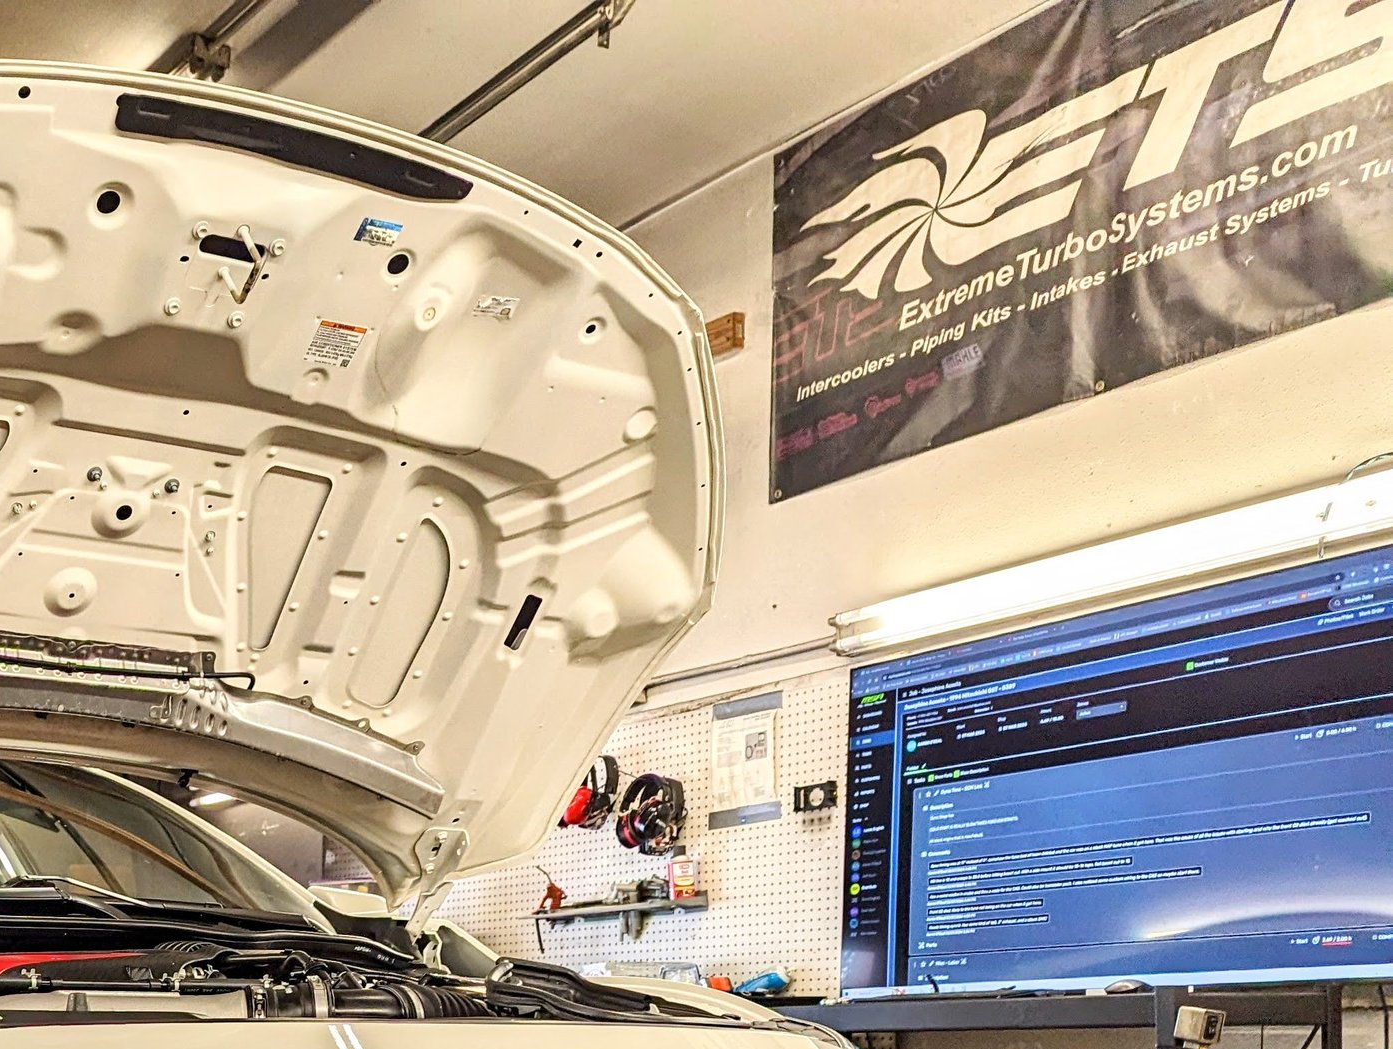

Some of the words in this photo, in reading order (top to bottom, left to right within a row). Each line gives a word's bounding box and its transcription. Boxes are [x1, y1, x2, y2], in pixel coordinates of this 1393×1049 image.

[797, 353, 895, 402] Intercoolers
[910, 322, 965, 358] Piping
[970, 305, 1012, 331] Kits
[1030, 269, 1106, 311] Intakes
[1122, 223, 1220, 275] Exhaust
[1225, 181, 1330, 236] Systems
[1359, 159, 1393, 183] Tu
